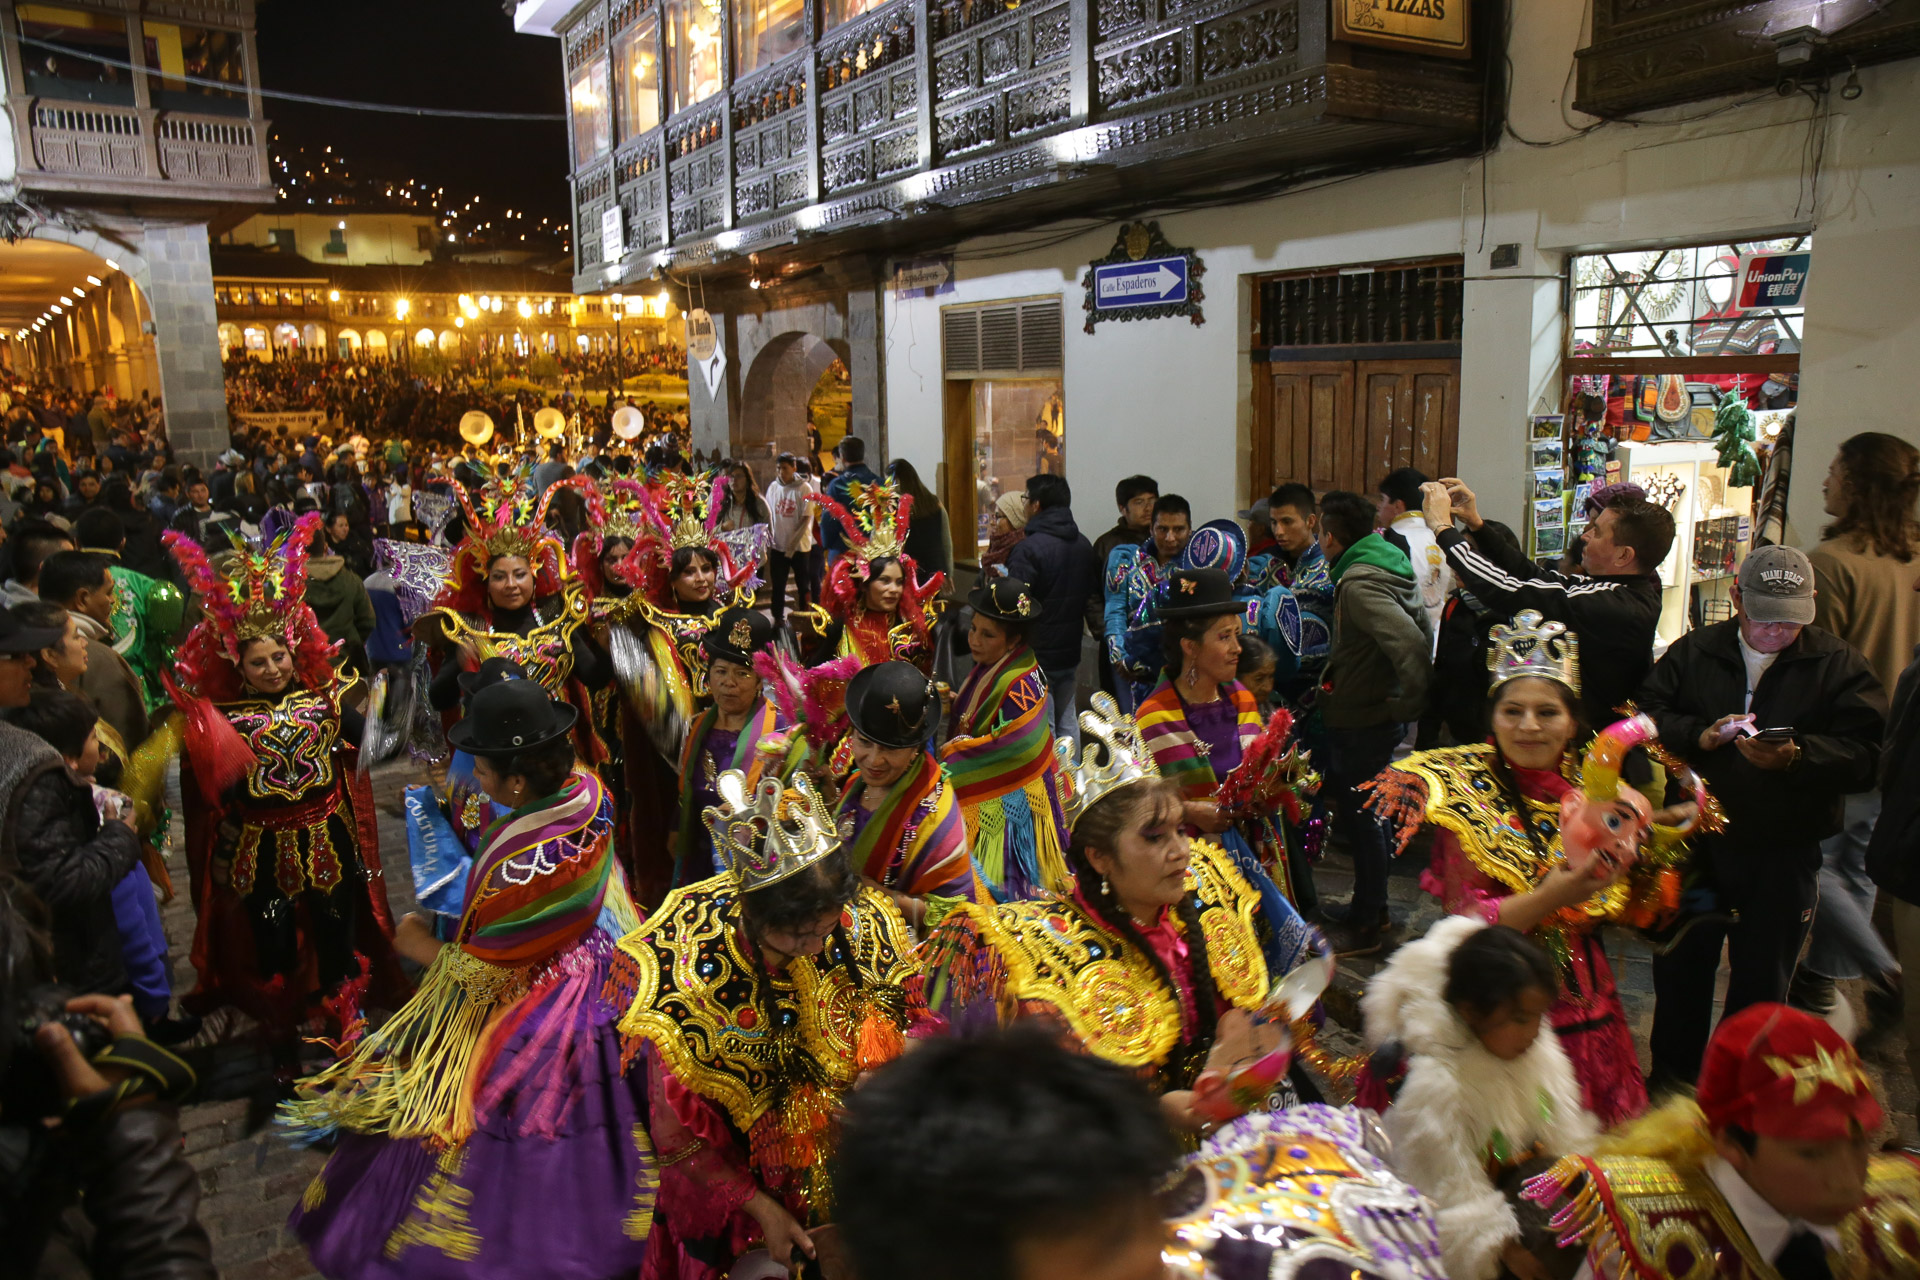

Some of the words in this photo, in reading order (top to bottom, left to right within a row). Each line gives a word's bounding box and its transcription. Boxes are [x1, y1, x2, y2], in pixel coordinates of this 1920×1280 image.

[1747, 268, 1805, 285] UnionPay
[1102, 282, 1115, 293] Calle
[1116, 277, 1157, 294] Espaderos
[1766, 283, 1798, 297] 银联
[1760, 569, 1783, 582] MIAMI
[1783, 570, 1805, 586] BEACH
[405, 796, 439, 873] CULTURAL
